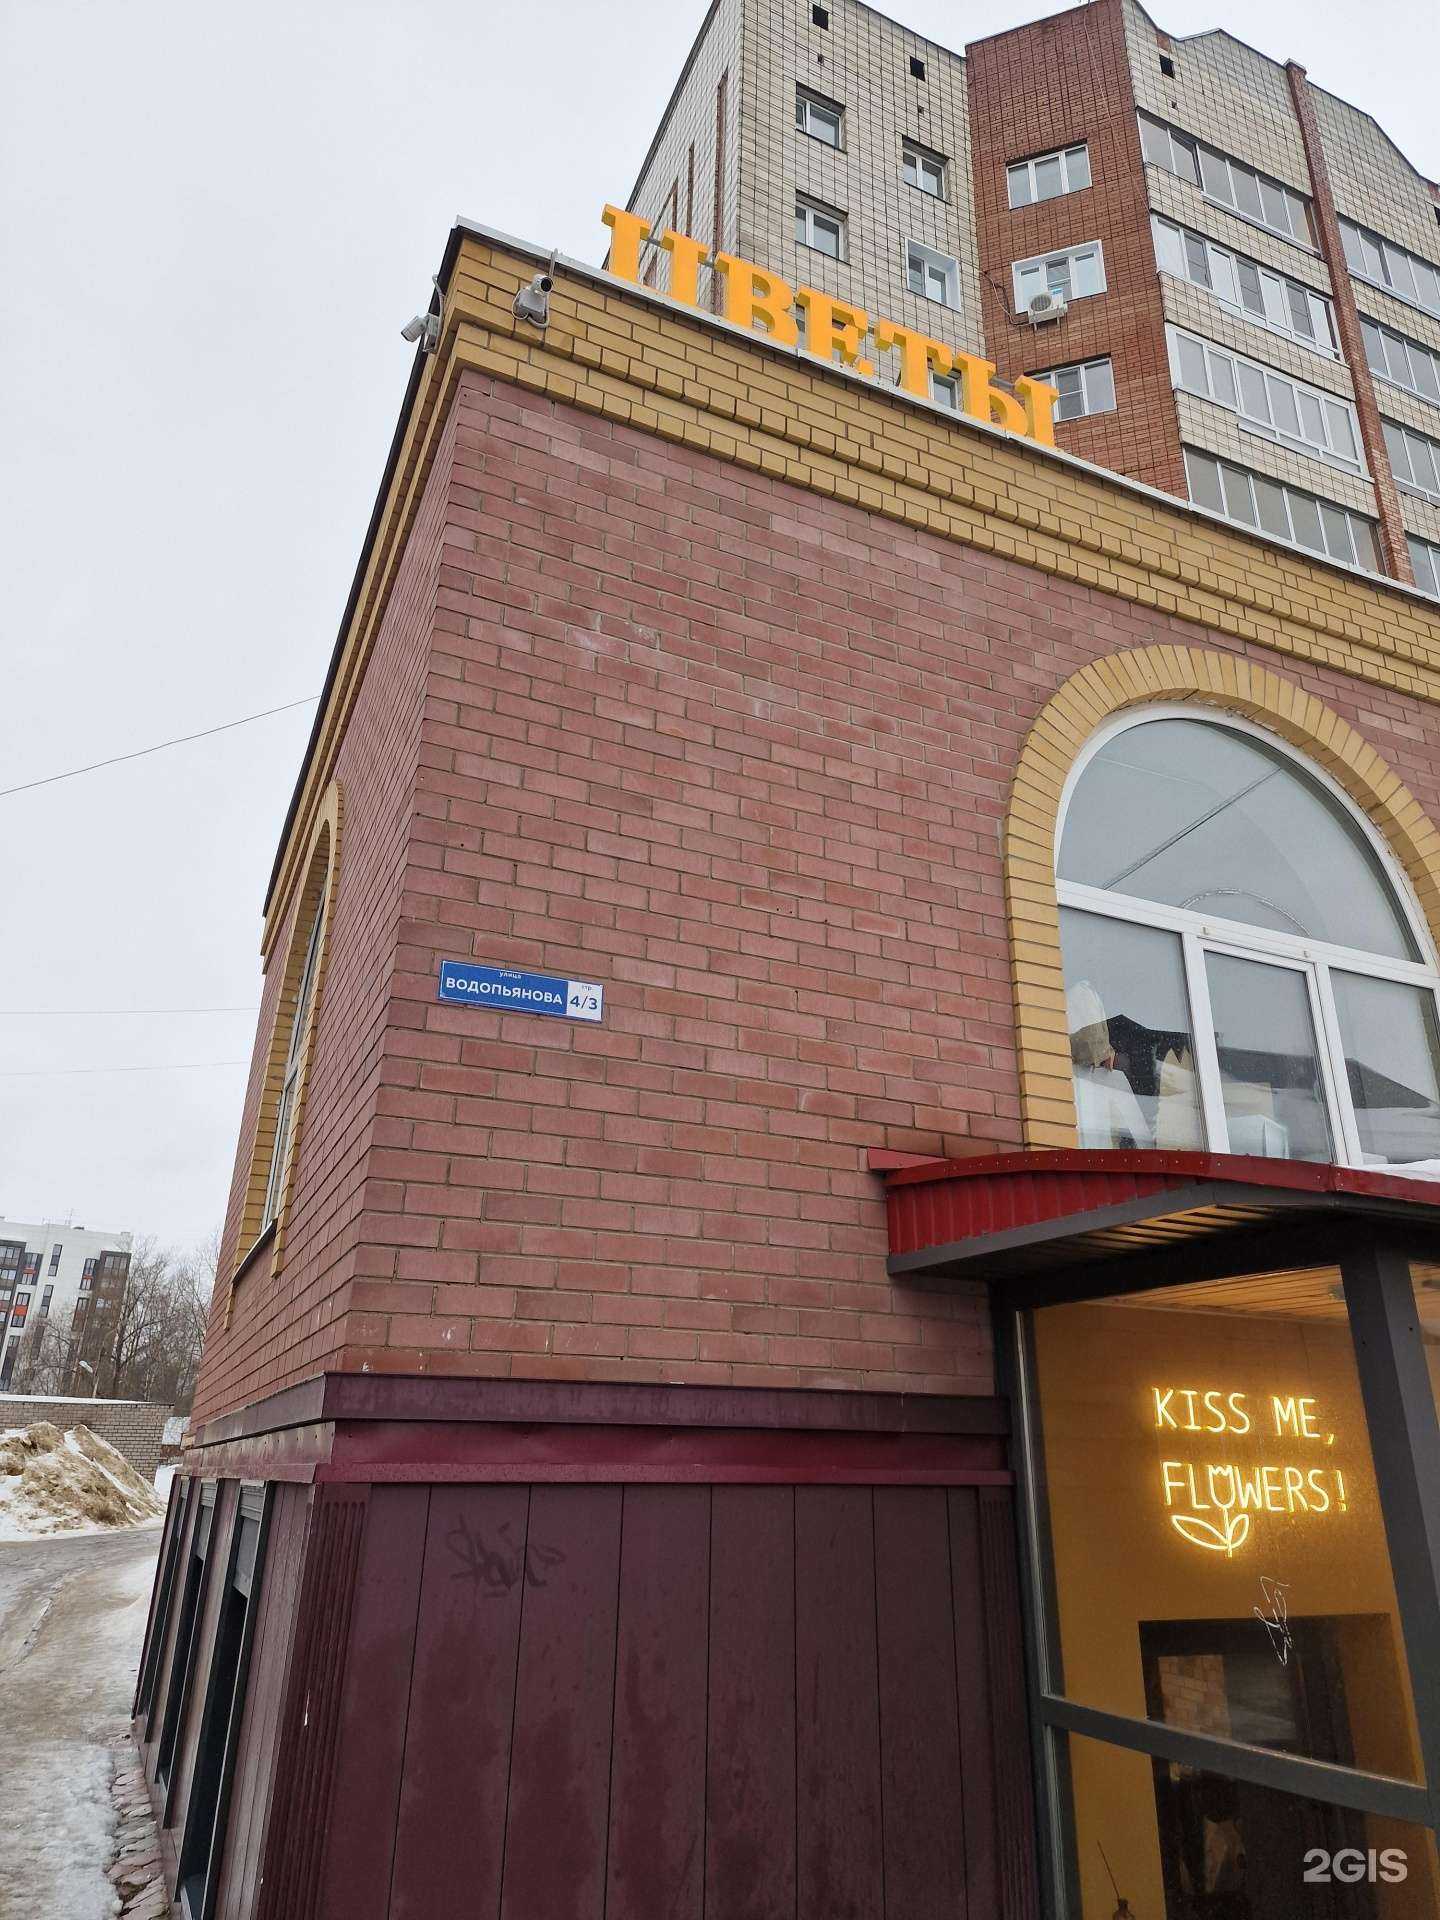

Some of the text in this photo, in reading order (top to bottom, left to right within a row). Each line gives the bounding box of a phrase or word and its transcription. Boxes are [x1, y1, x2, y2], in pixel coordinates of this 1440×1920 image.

[601, 203, 1059, 447] ЦВЕТЫ
[446, 977, 563, 1005] ВОДОПЬЯНОВА
[499, 971, 522, 980] улица
[570, 995, 598, 1010] 4/3
[1152, 1387, 1335, 1445] KISS ME,
[1162, 1461, 1347, 1513] FLOWERS!
